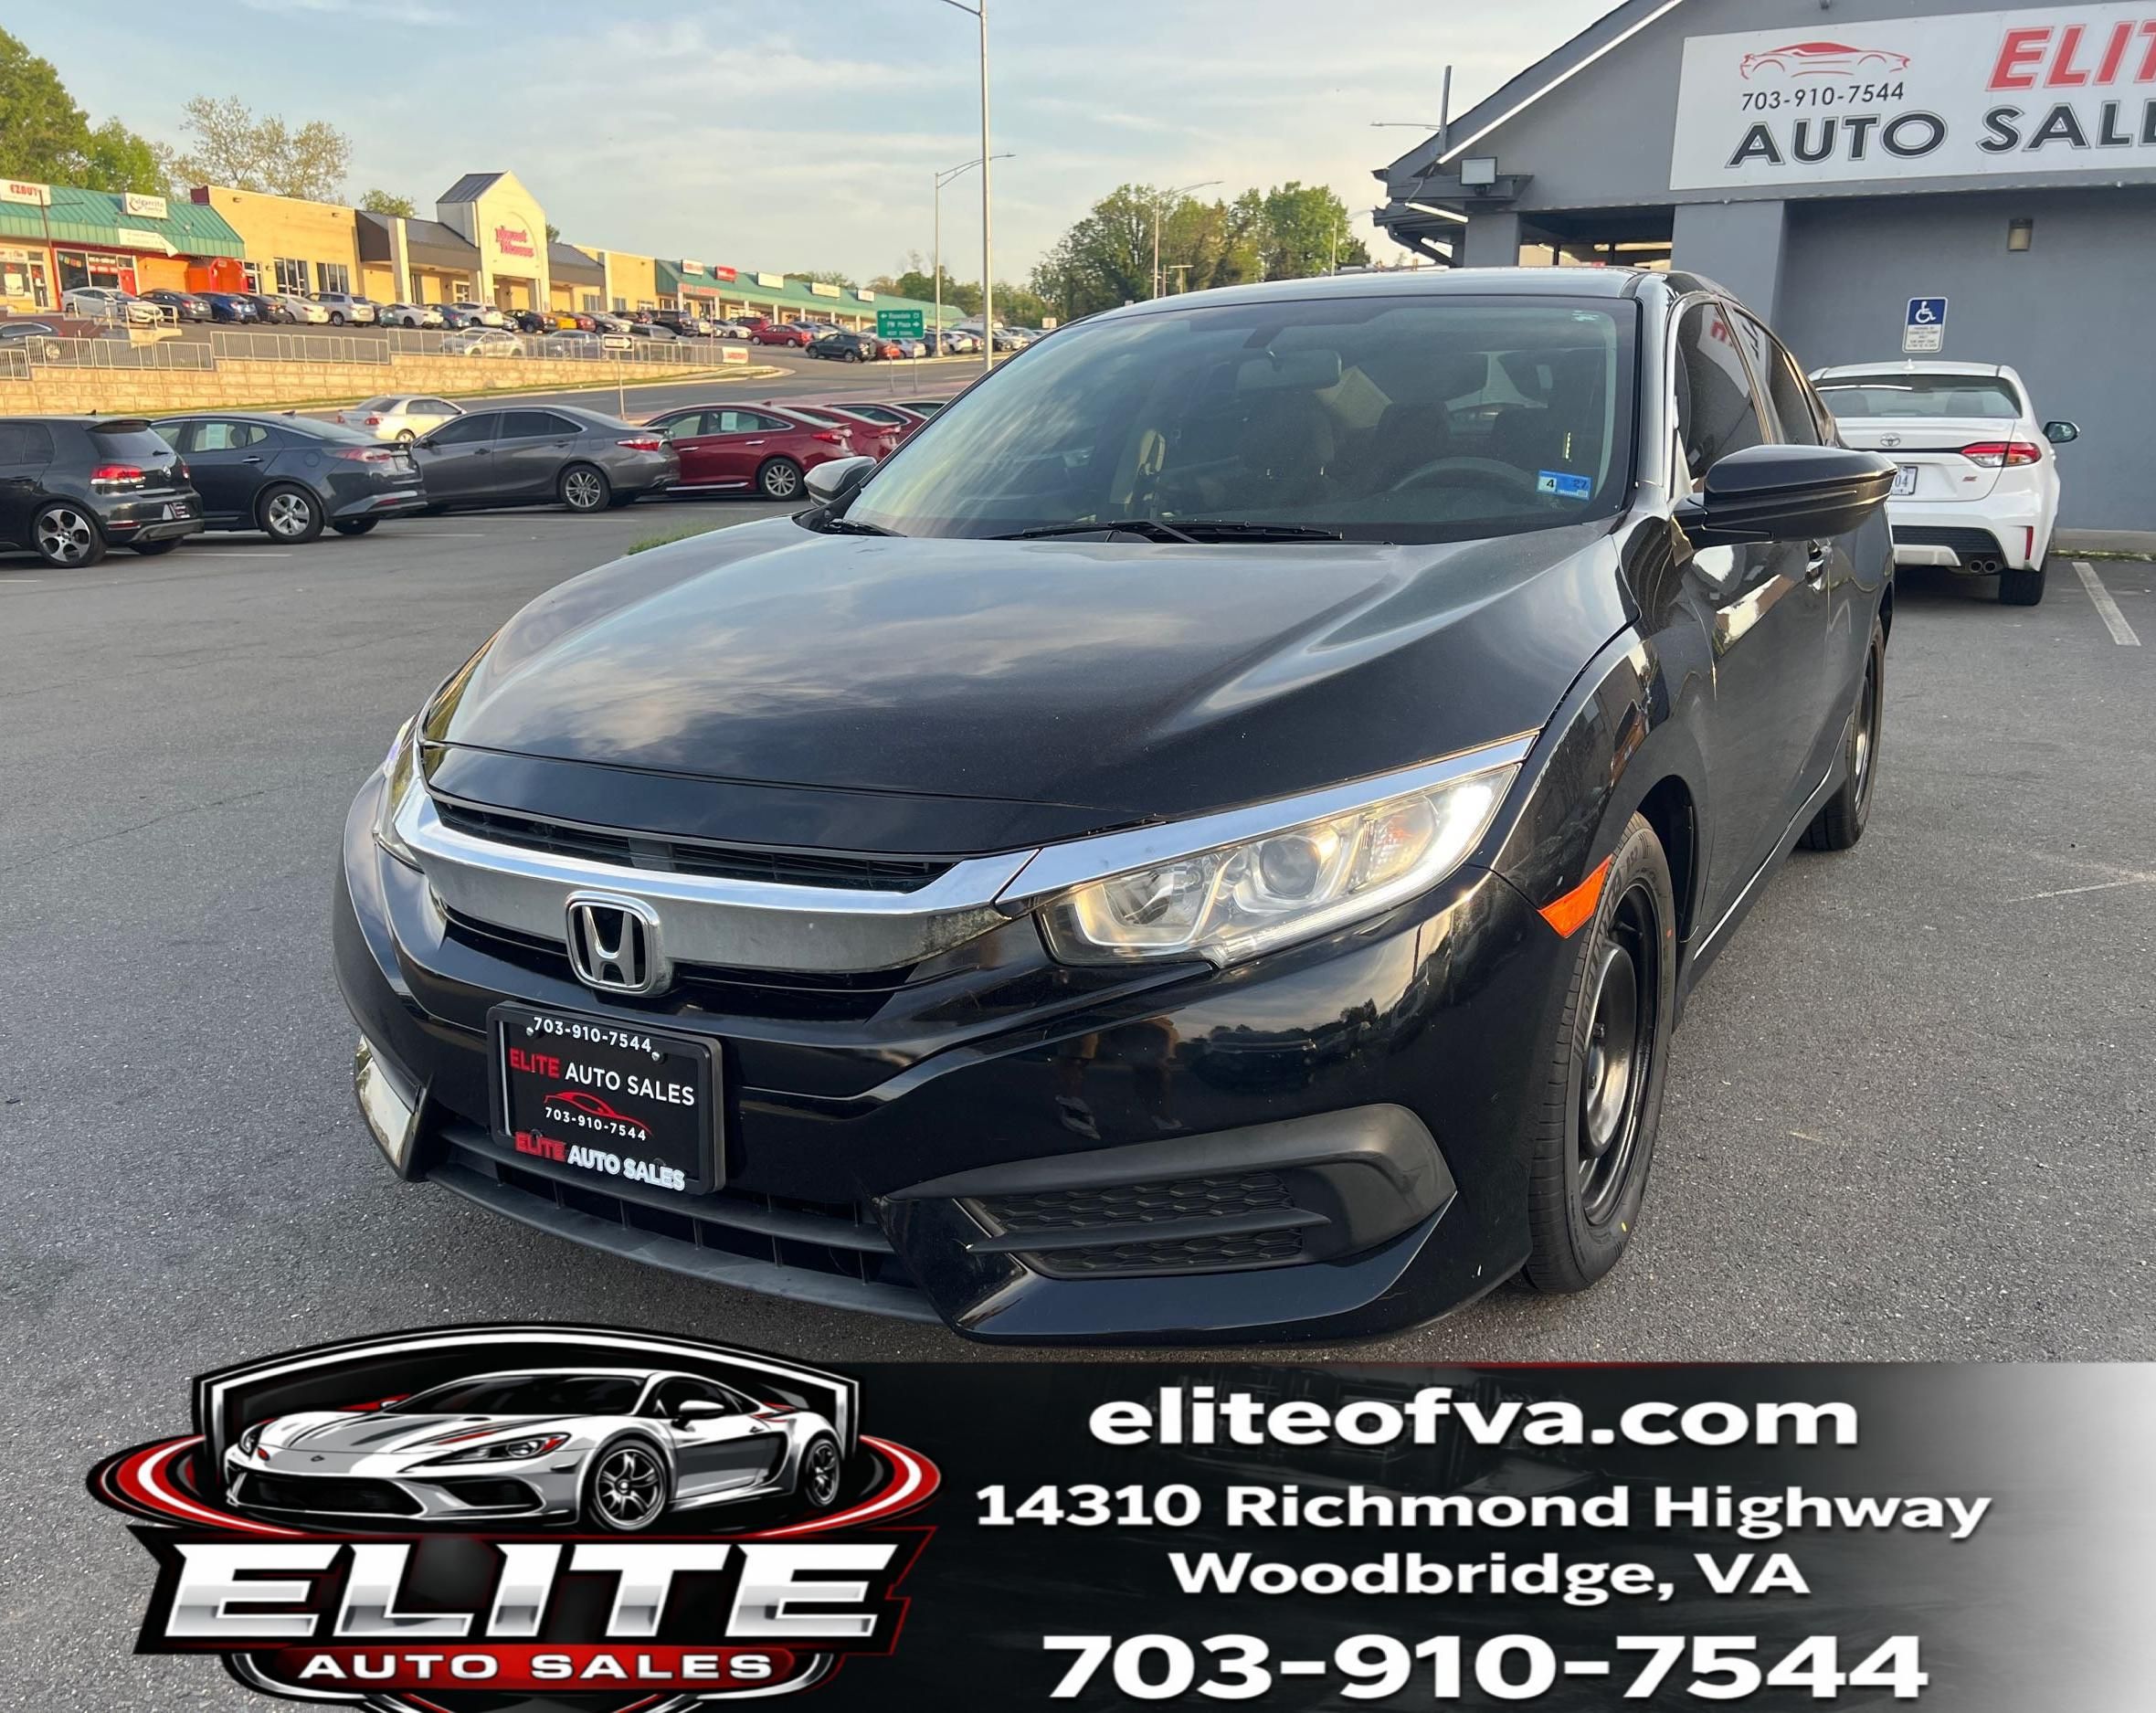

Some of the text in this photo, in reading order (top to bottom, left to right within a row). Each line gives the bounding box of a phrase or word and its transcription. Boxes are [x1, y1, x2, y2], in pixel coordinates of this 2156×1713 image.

[1741, 81, 1905, 111] 703-910-7544
[1726, 110, 1950, 168] AUTO
[534, 1017, 651, 1052] 703-910-7544
[509, 1048, 695, 1106] ELITE AUTO SALES
[544, 1106, 647, 1141] 703-910-7544
[515, 1130, 685, 1191] ELITE AUTO SALES
